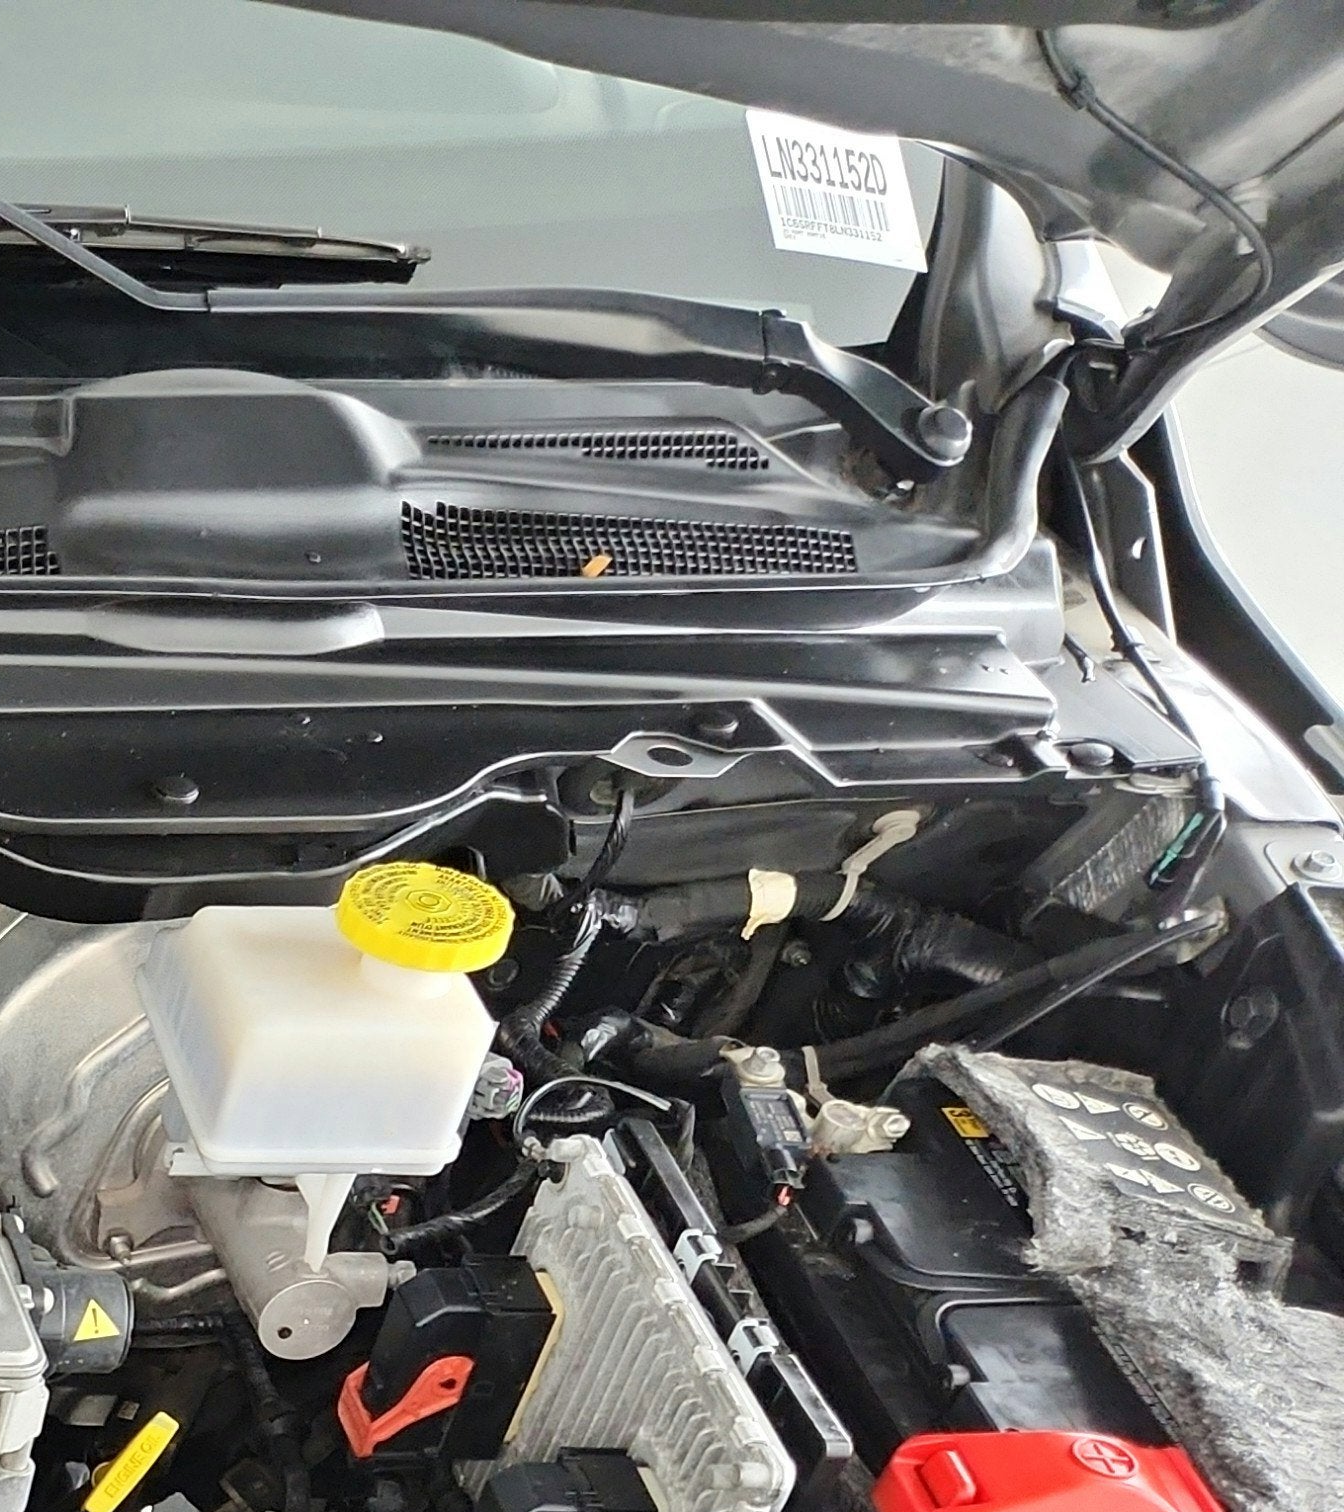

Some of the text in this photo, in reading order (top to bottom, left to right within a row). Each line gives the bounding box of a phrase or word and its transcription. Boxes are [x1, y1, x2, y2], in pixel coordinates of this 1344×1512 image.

[761, 134, 888, 196] LN331152D
[105, 1432, 163, 1499] ENGINE OIL
